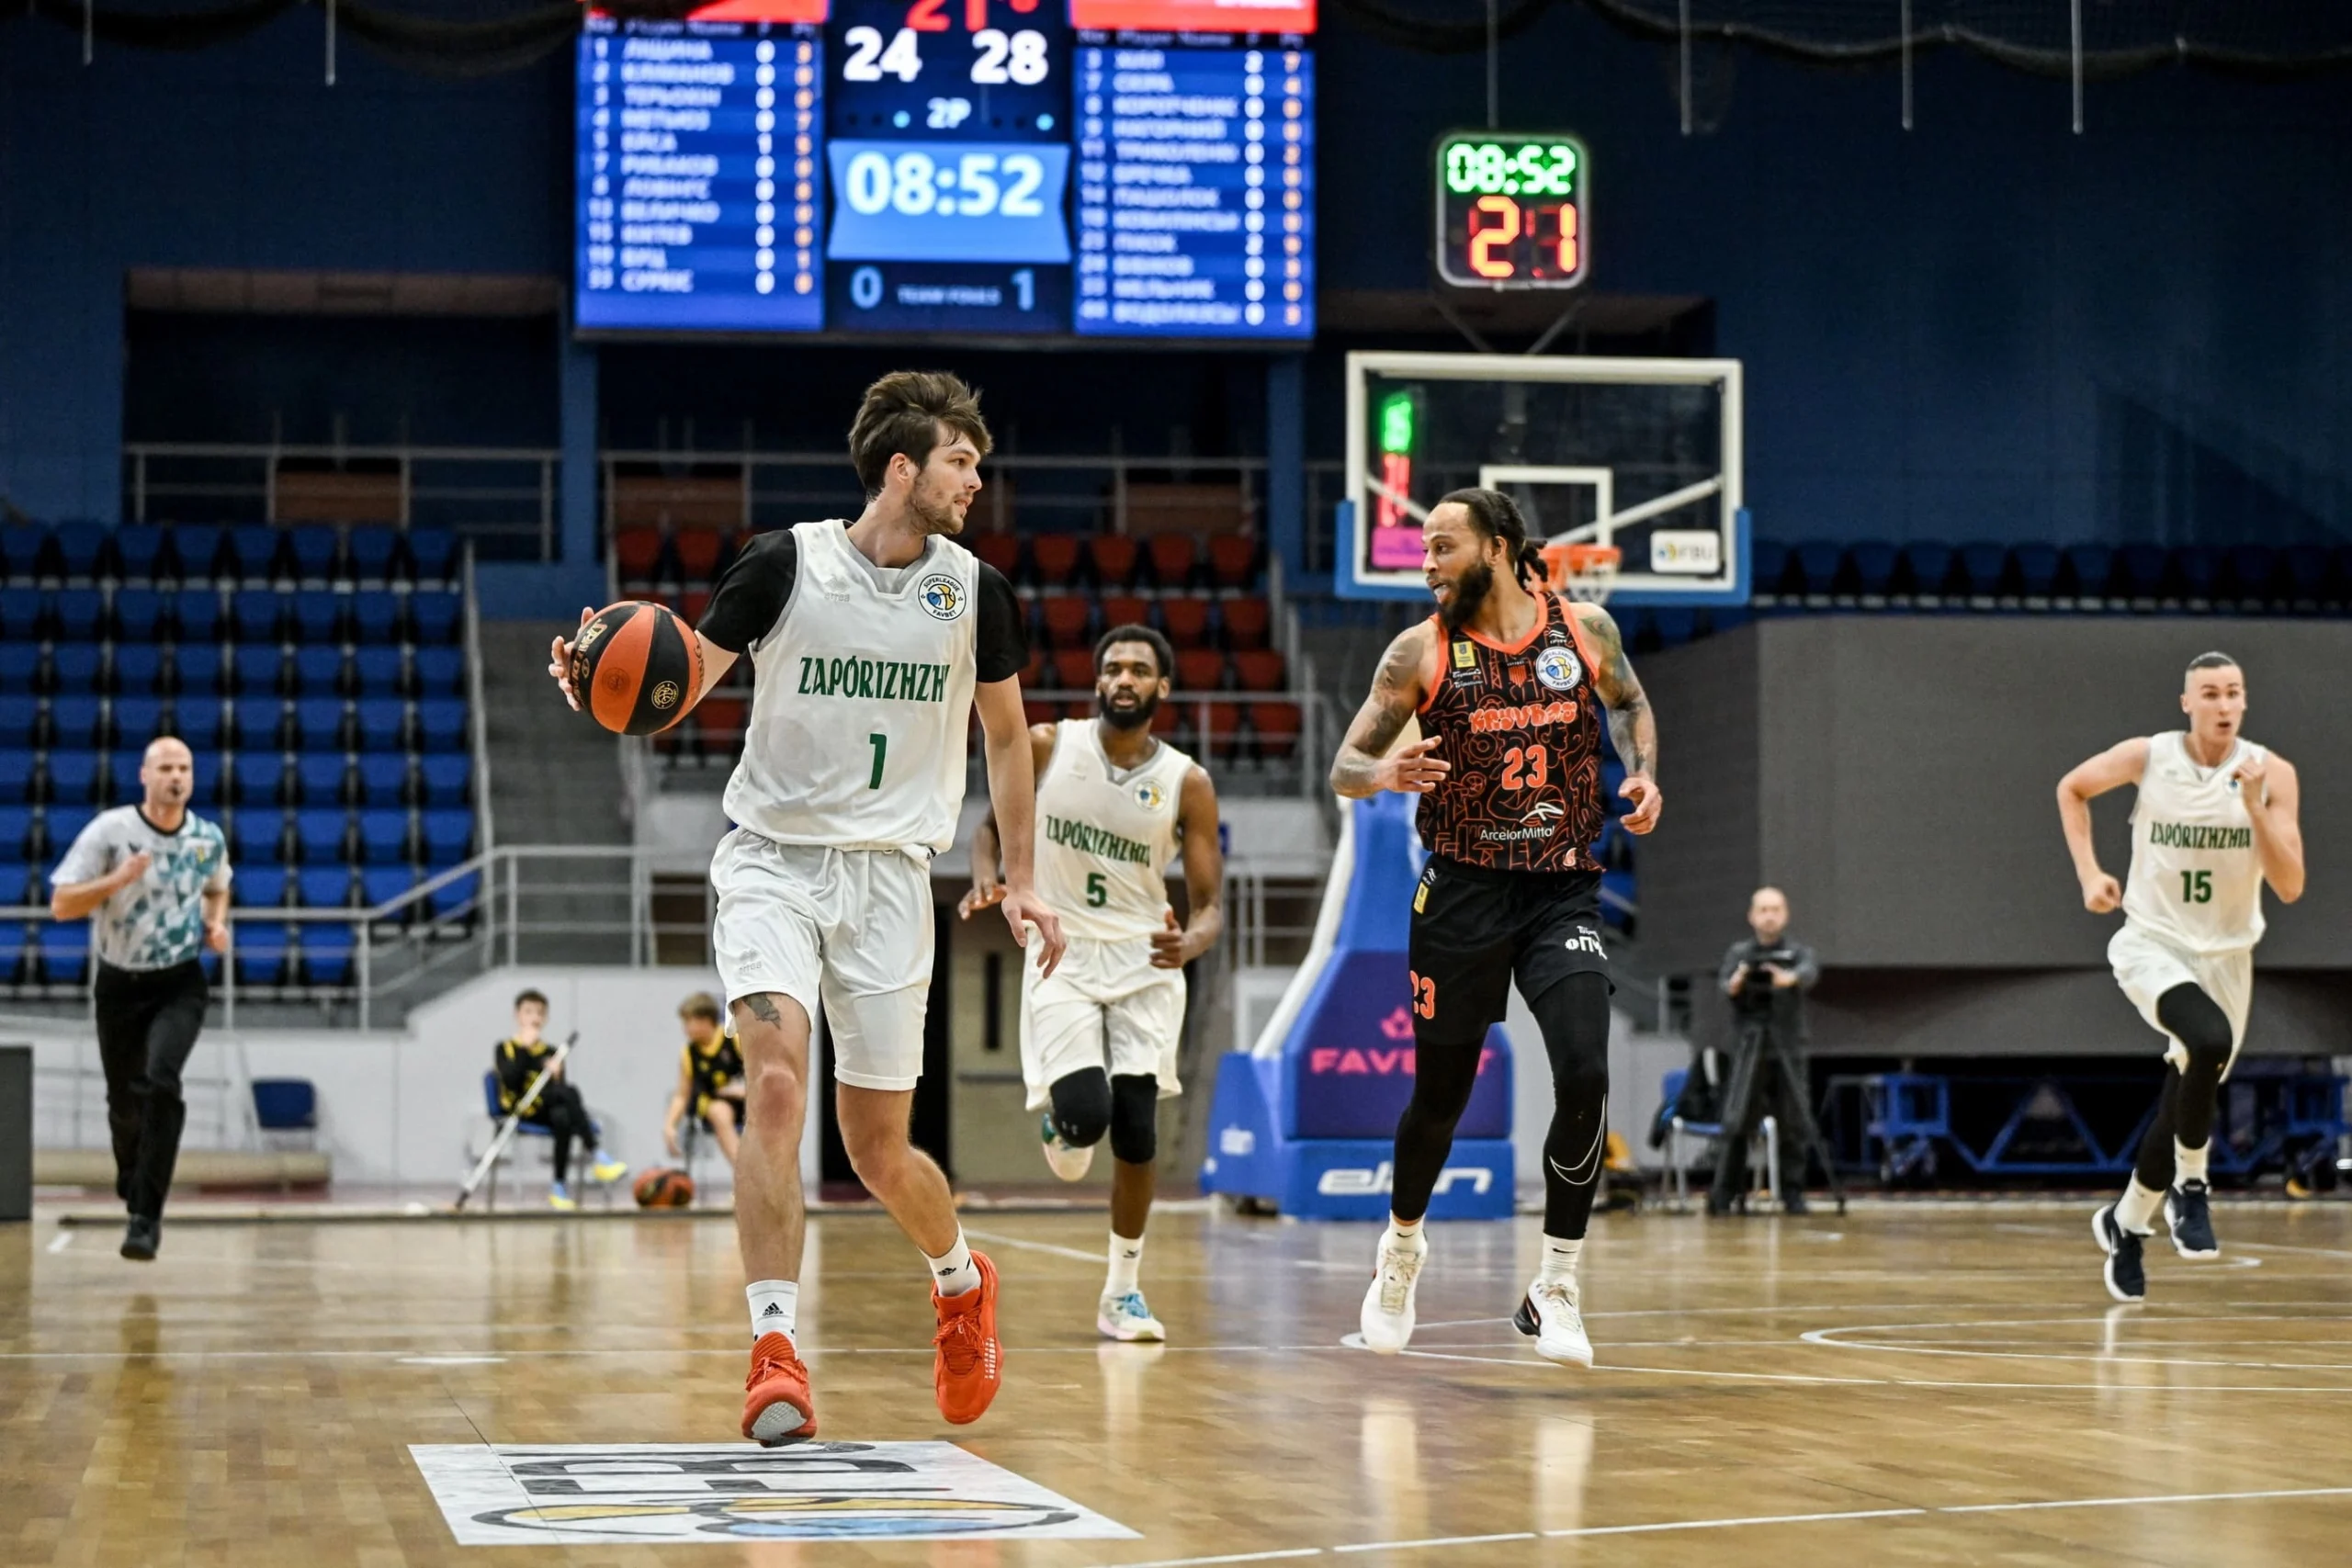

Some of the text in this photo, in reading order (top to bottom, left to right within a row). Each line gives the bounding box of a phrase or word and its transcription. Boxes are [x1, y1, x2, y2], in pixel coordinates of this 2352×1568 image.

[842, 26, 922, 82] 24
[970, 28, 1049, 85] 28
[845, 151, 1045, 217] 08:52
[1447, 143, 1577, 195] 08:52
[1470, 196, 1577, 277] 21
[851, 265, 883, 310] 0
[1012, 268, 1035, 311] 1
[933, 609, 957, 618] FAVBET
[868, 733, 888, 790] 1
[1501, 744, 1547, 791] 23
[1480, 826, 1555, 840] ArcelorMittal
[1087, 872, 1107, 908] 5
[2179, 870, 2212, 904] 15
[1318, 1161, 1493, 1194] eln
